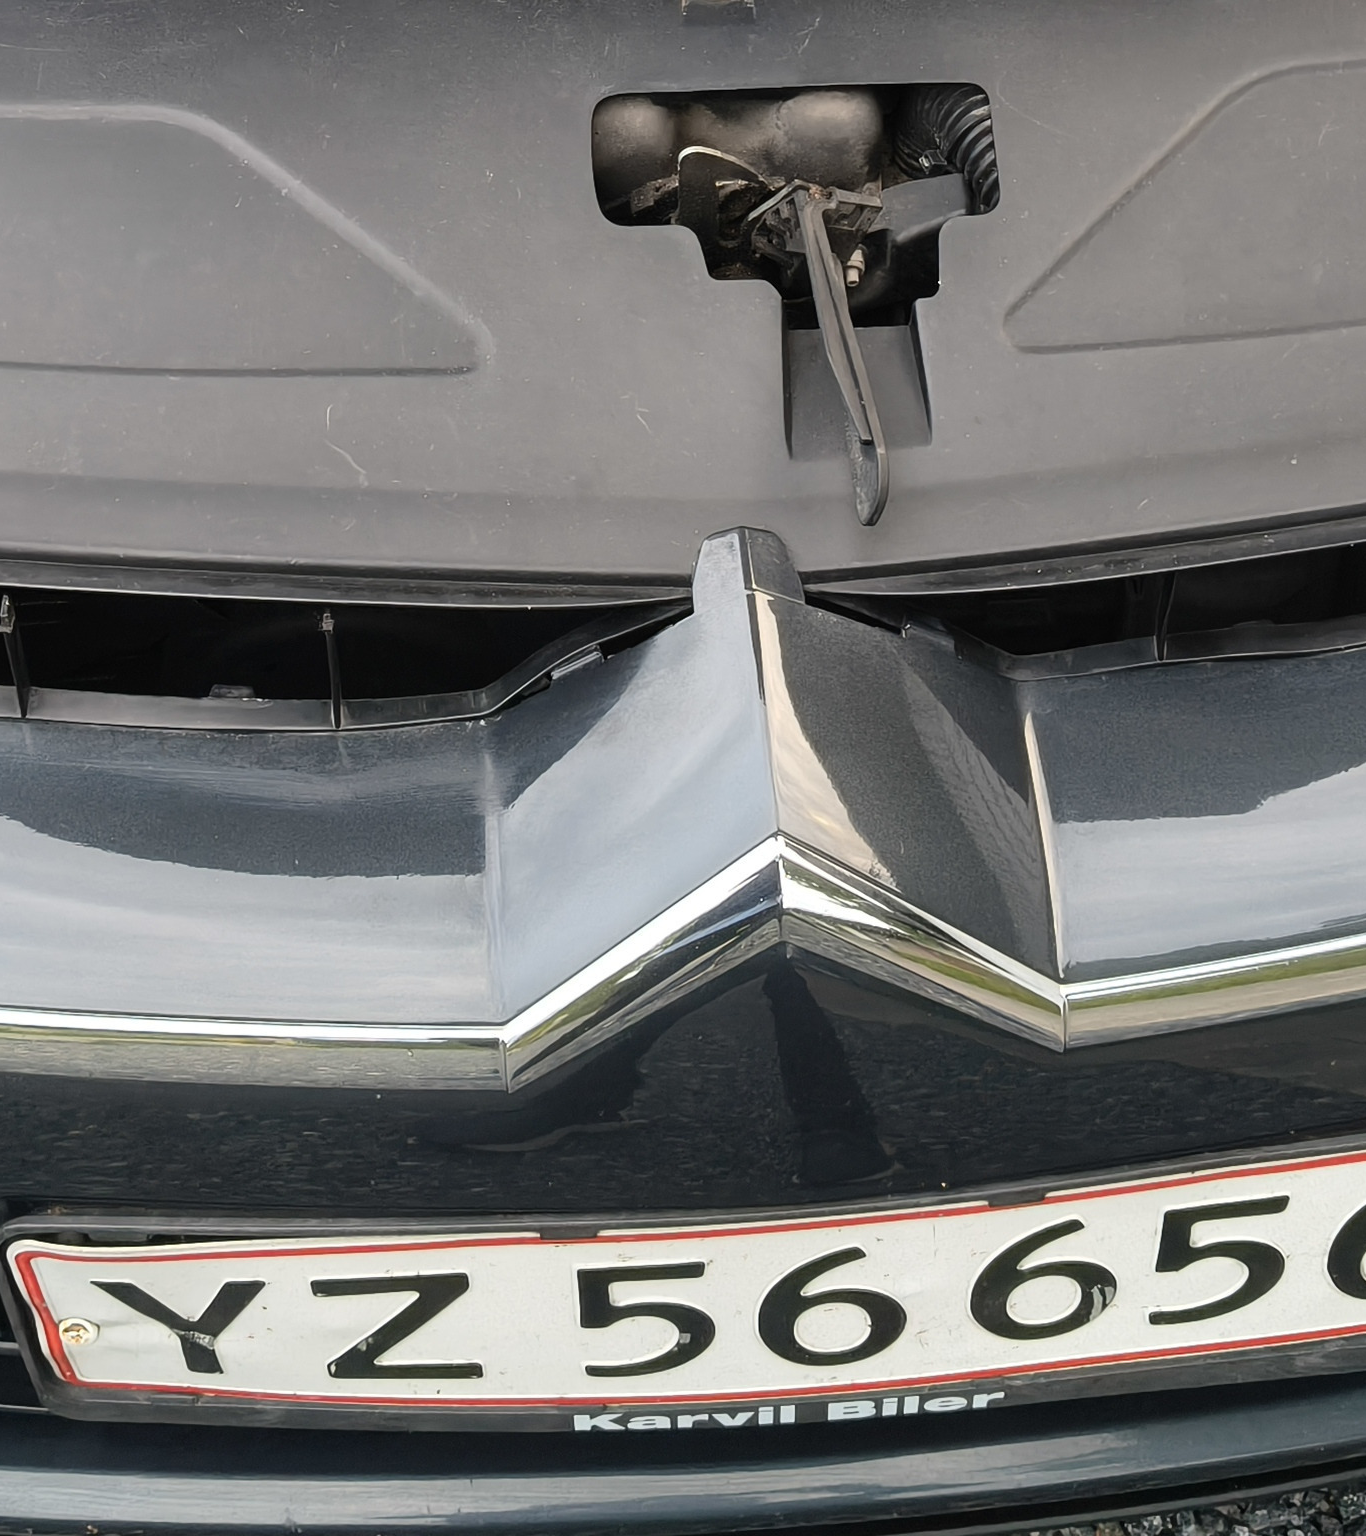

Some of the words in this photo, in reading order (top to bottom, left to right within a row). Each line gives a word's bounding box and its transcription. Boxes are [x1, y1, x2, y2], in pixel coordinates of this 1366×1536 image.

[89, 1271, 483, 1379] YZ
[577, 1245, 908, 1378] 56
[572, 1404, 796, 1432] Karvil
[827, 1389, 1006, 1421] Biler
